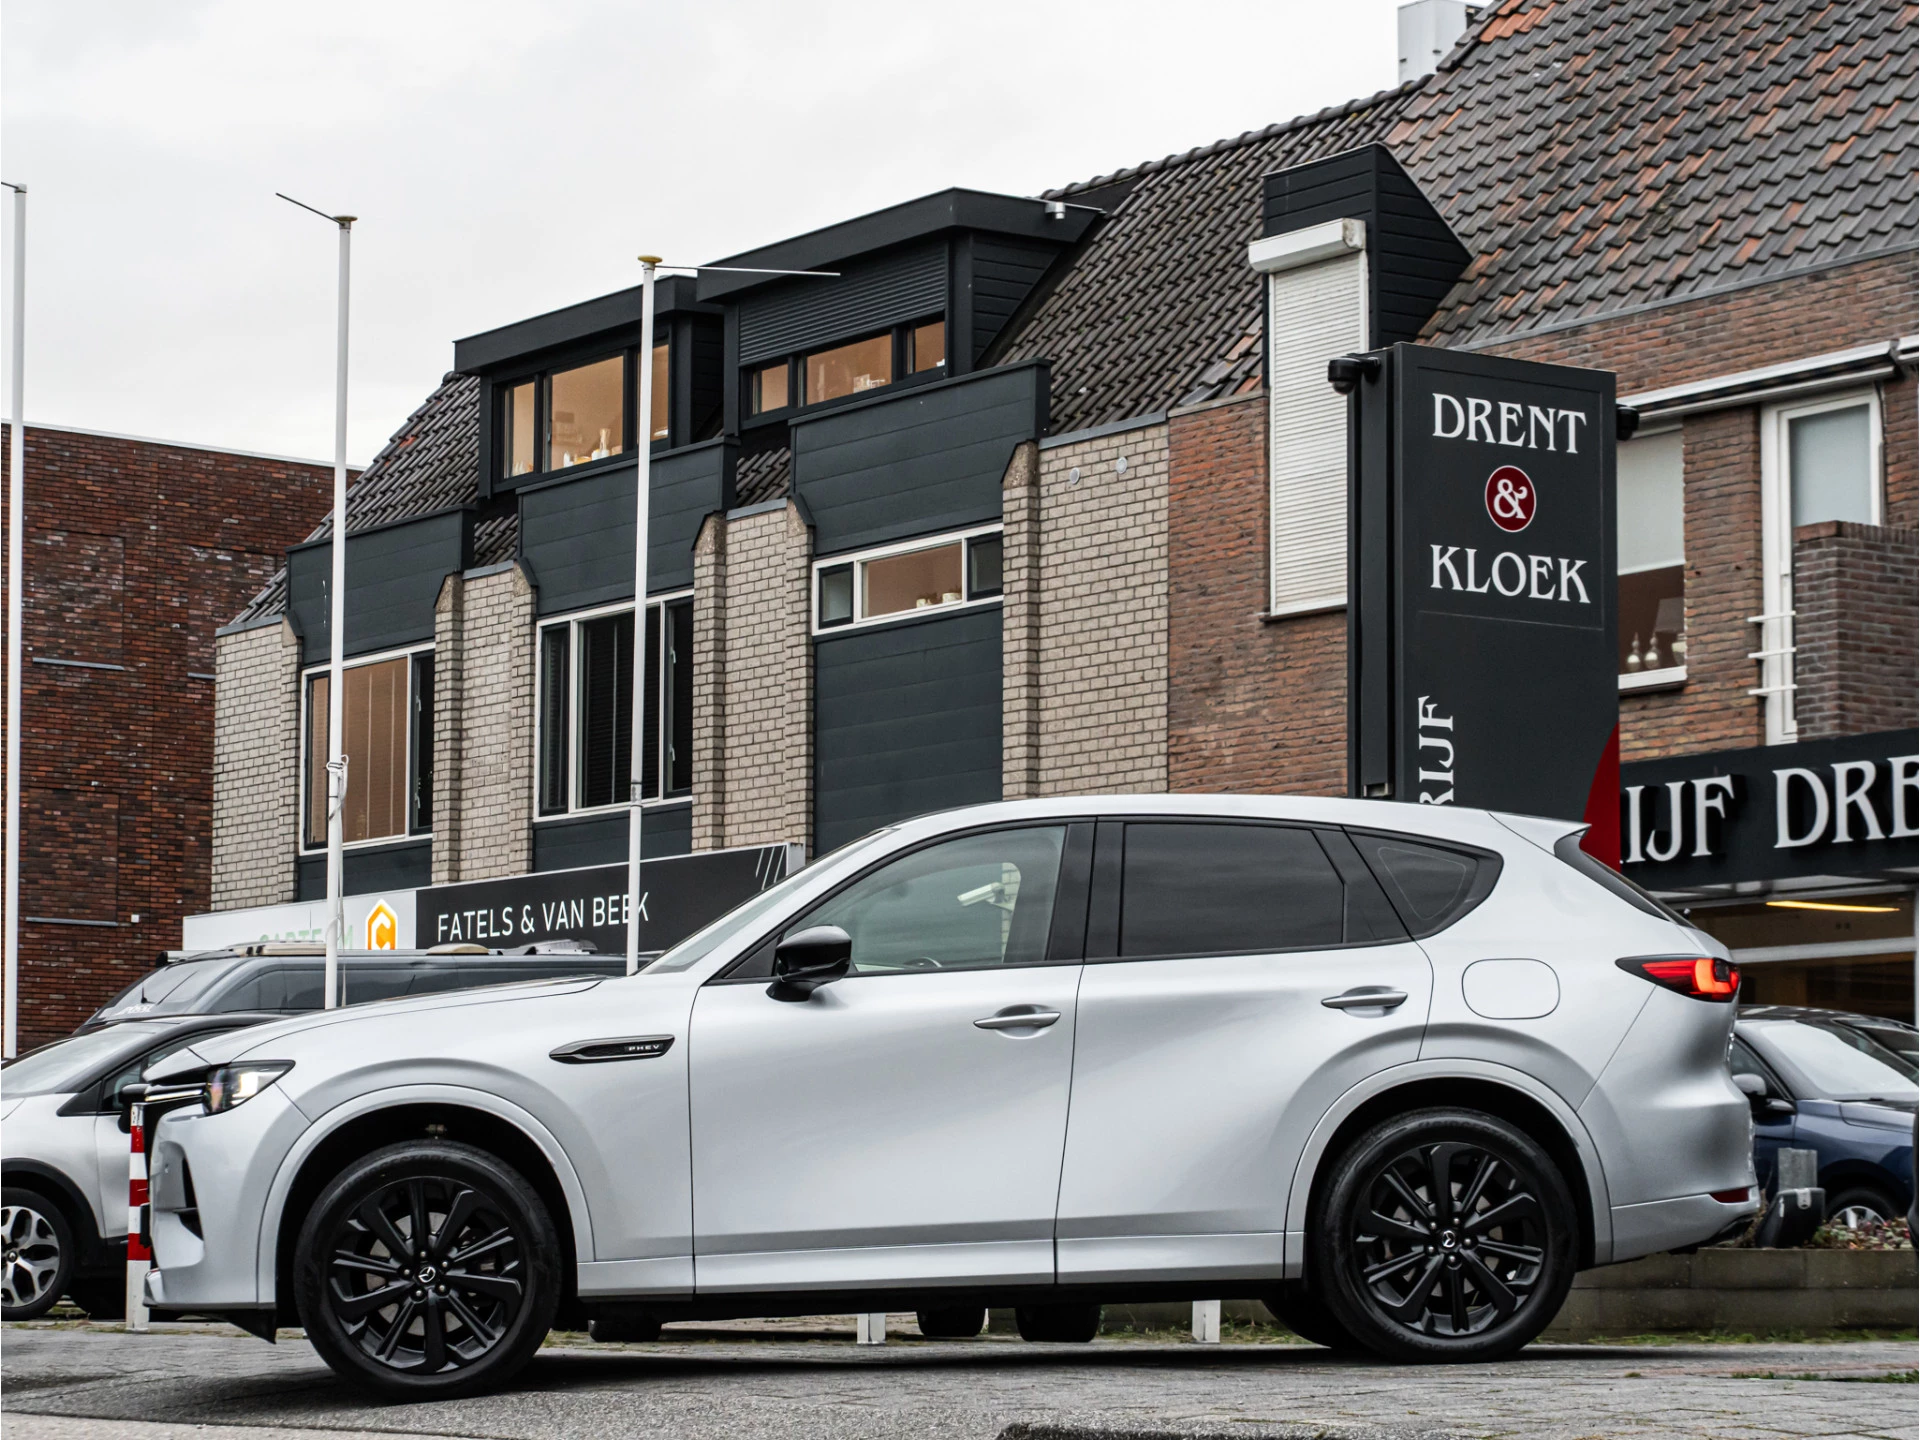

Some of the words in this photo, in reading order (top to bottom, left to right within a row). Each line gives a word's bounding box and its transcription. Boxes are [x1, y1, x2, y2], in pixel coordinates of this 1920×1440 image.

[1431, 392, 1587, 454] DRENT
[1493, 478, 1528, 519] &
[1430, 543, 1591, 604] KLOEK
[1620, 774, 1735, 864] IJF
[437, 905, 514, 943] FATELS
[520, 904, 535, 935] &
[542, 898, 584, 932] VAN
[592, 891, 649, 927] BEEK
[628, 1043, 660, 1051] PHEV
